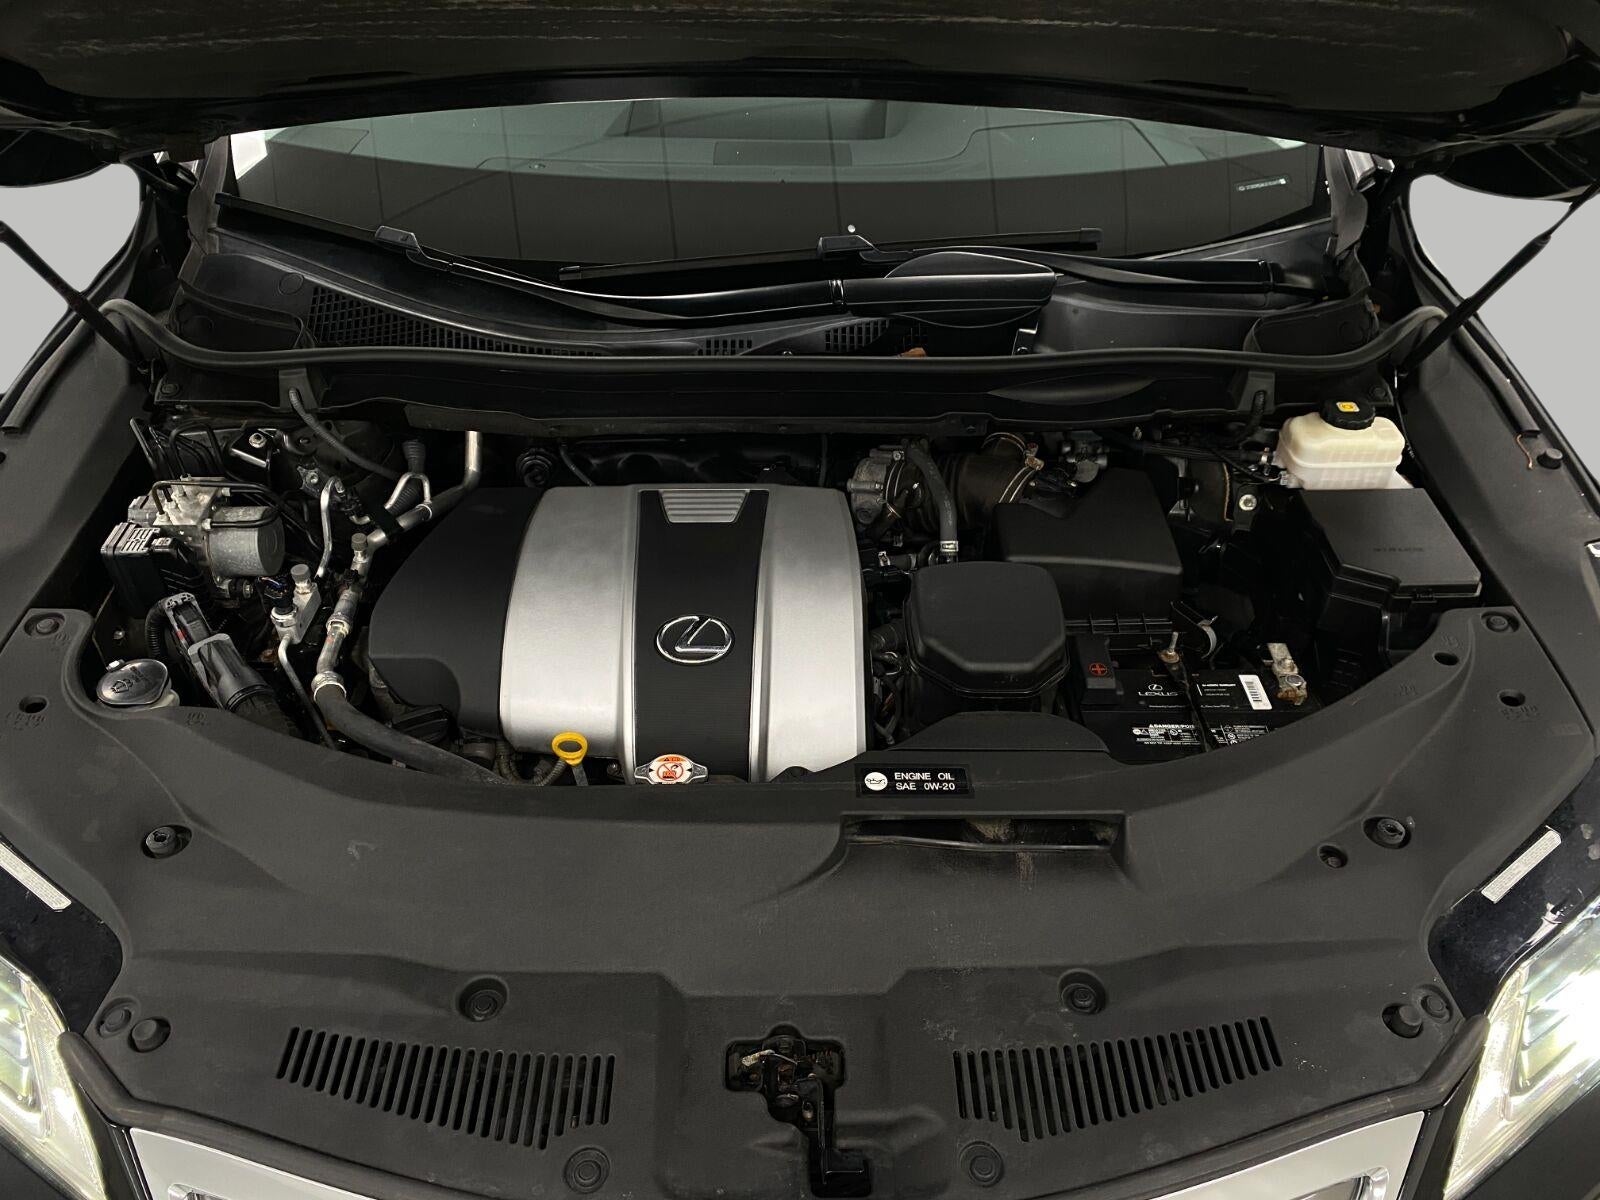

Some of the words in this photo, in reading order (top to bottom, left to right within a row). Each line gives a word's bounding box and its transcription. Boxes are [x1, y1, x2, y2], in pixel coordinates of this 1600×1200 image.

[894, 772, 932, 781] ENGINE
[937, 772, 955, 781] OIL
[895, 782, 917, 791] SAE
[923, 782, 956, 791] 0W-20
